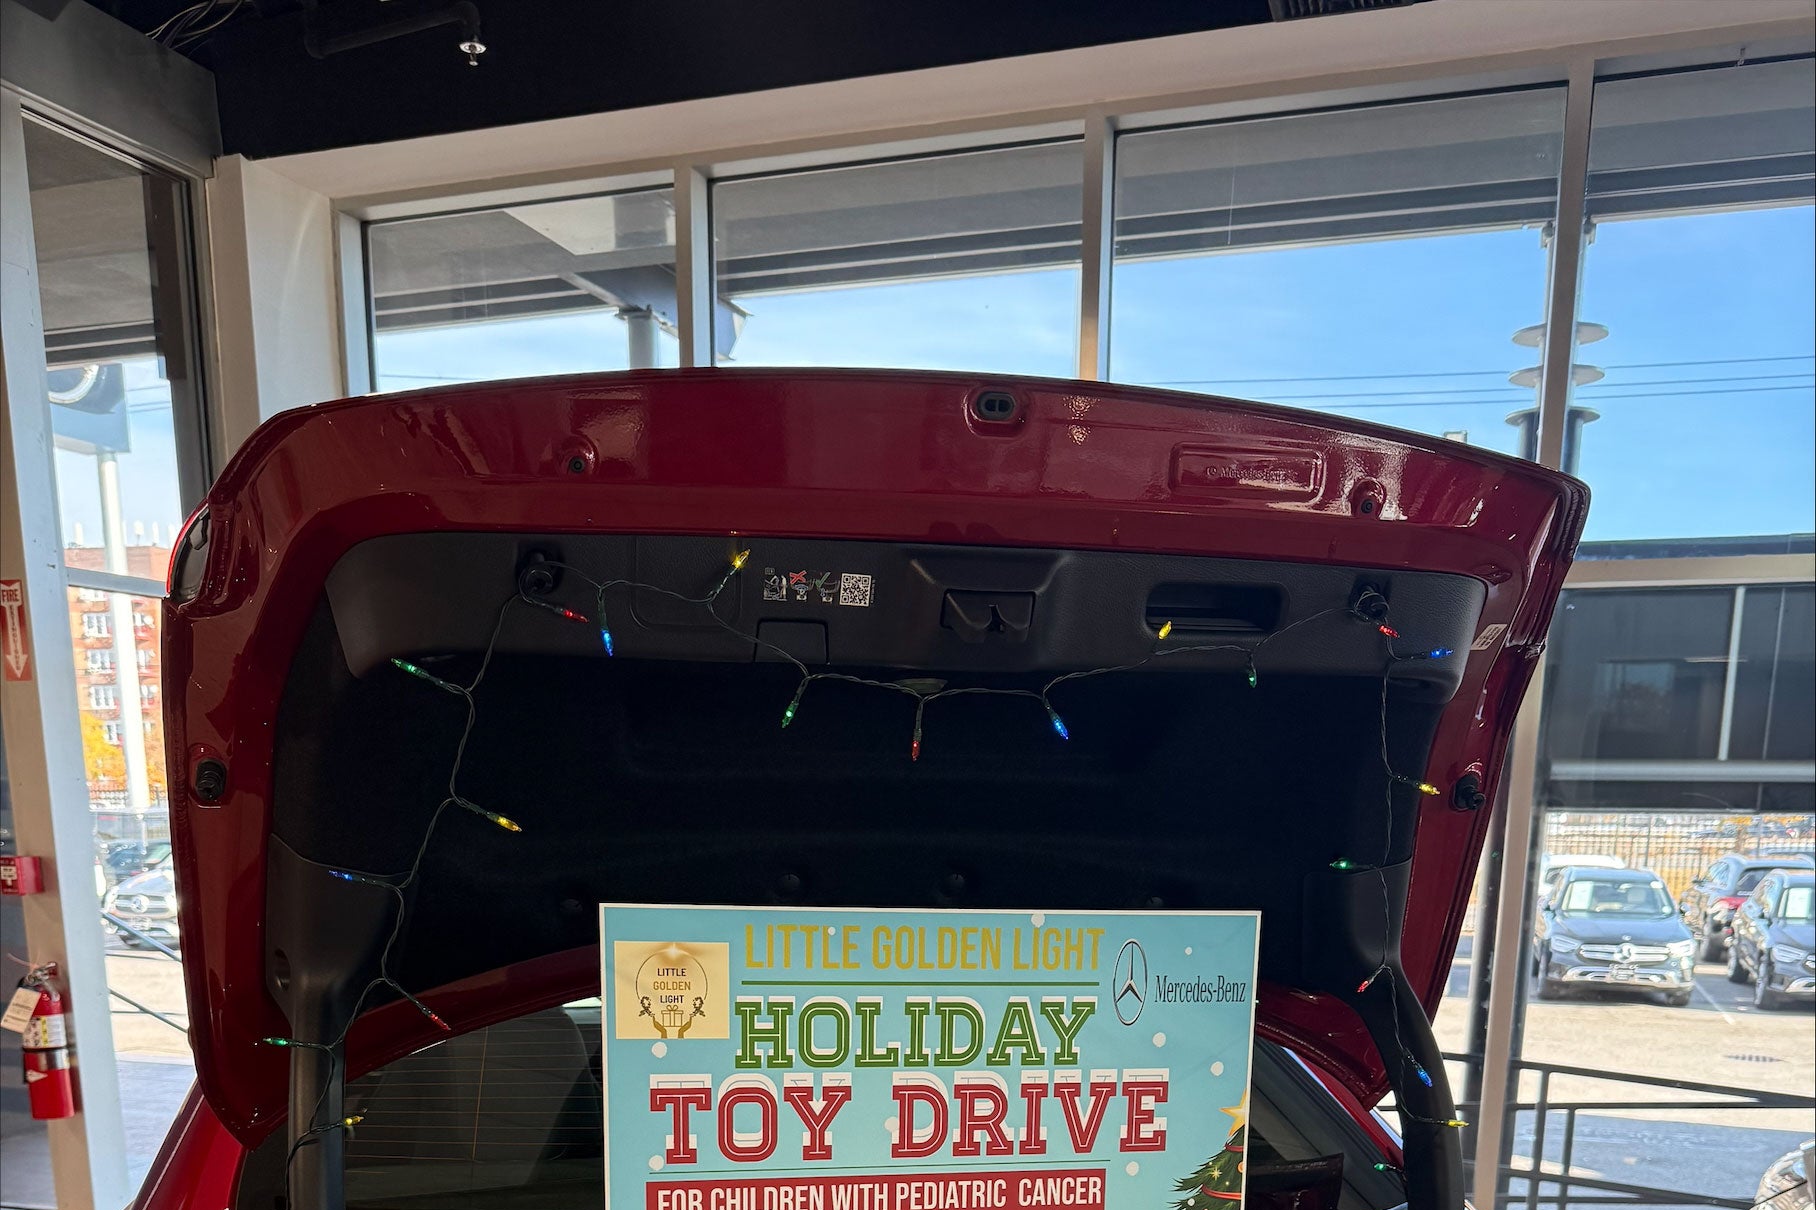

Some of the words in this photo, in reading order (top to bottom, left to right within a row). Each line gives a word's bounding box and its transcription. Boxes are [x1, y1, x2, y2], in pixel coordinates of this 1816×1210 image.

[1, 589, 19, 602] FIRE
[745, 924, 860, 971] LITTLE
[872, 925, 999, 971] GOLDEN
[1013, 927, 1105, 971] LIGHT
[653, 981, 691, 991] GOLDEN
[657, 968, 687, 977] LITTLE
[660, 995, 684, 1004] LIGHT
[1155, 975, 1246, 1004] Mercedes-Benz
[735, 996, 1097, 1068] HOLIDAY
[649, 1074, 852, 1164] TOY
[891, 1069, 1169, 1158] DRIVE
[896, 1179, 1007, 1210] PEDIATRIC
[1019, 1177, 1101, 1206] CANCER
